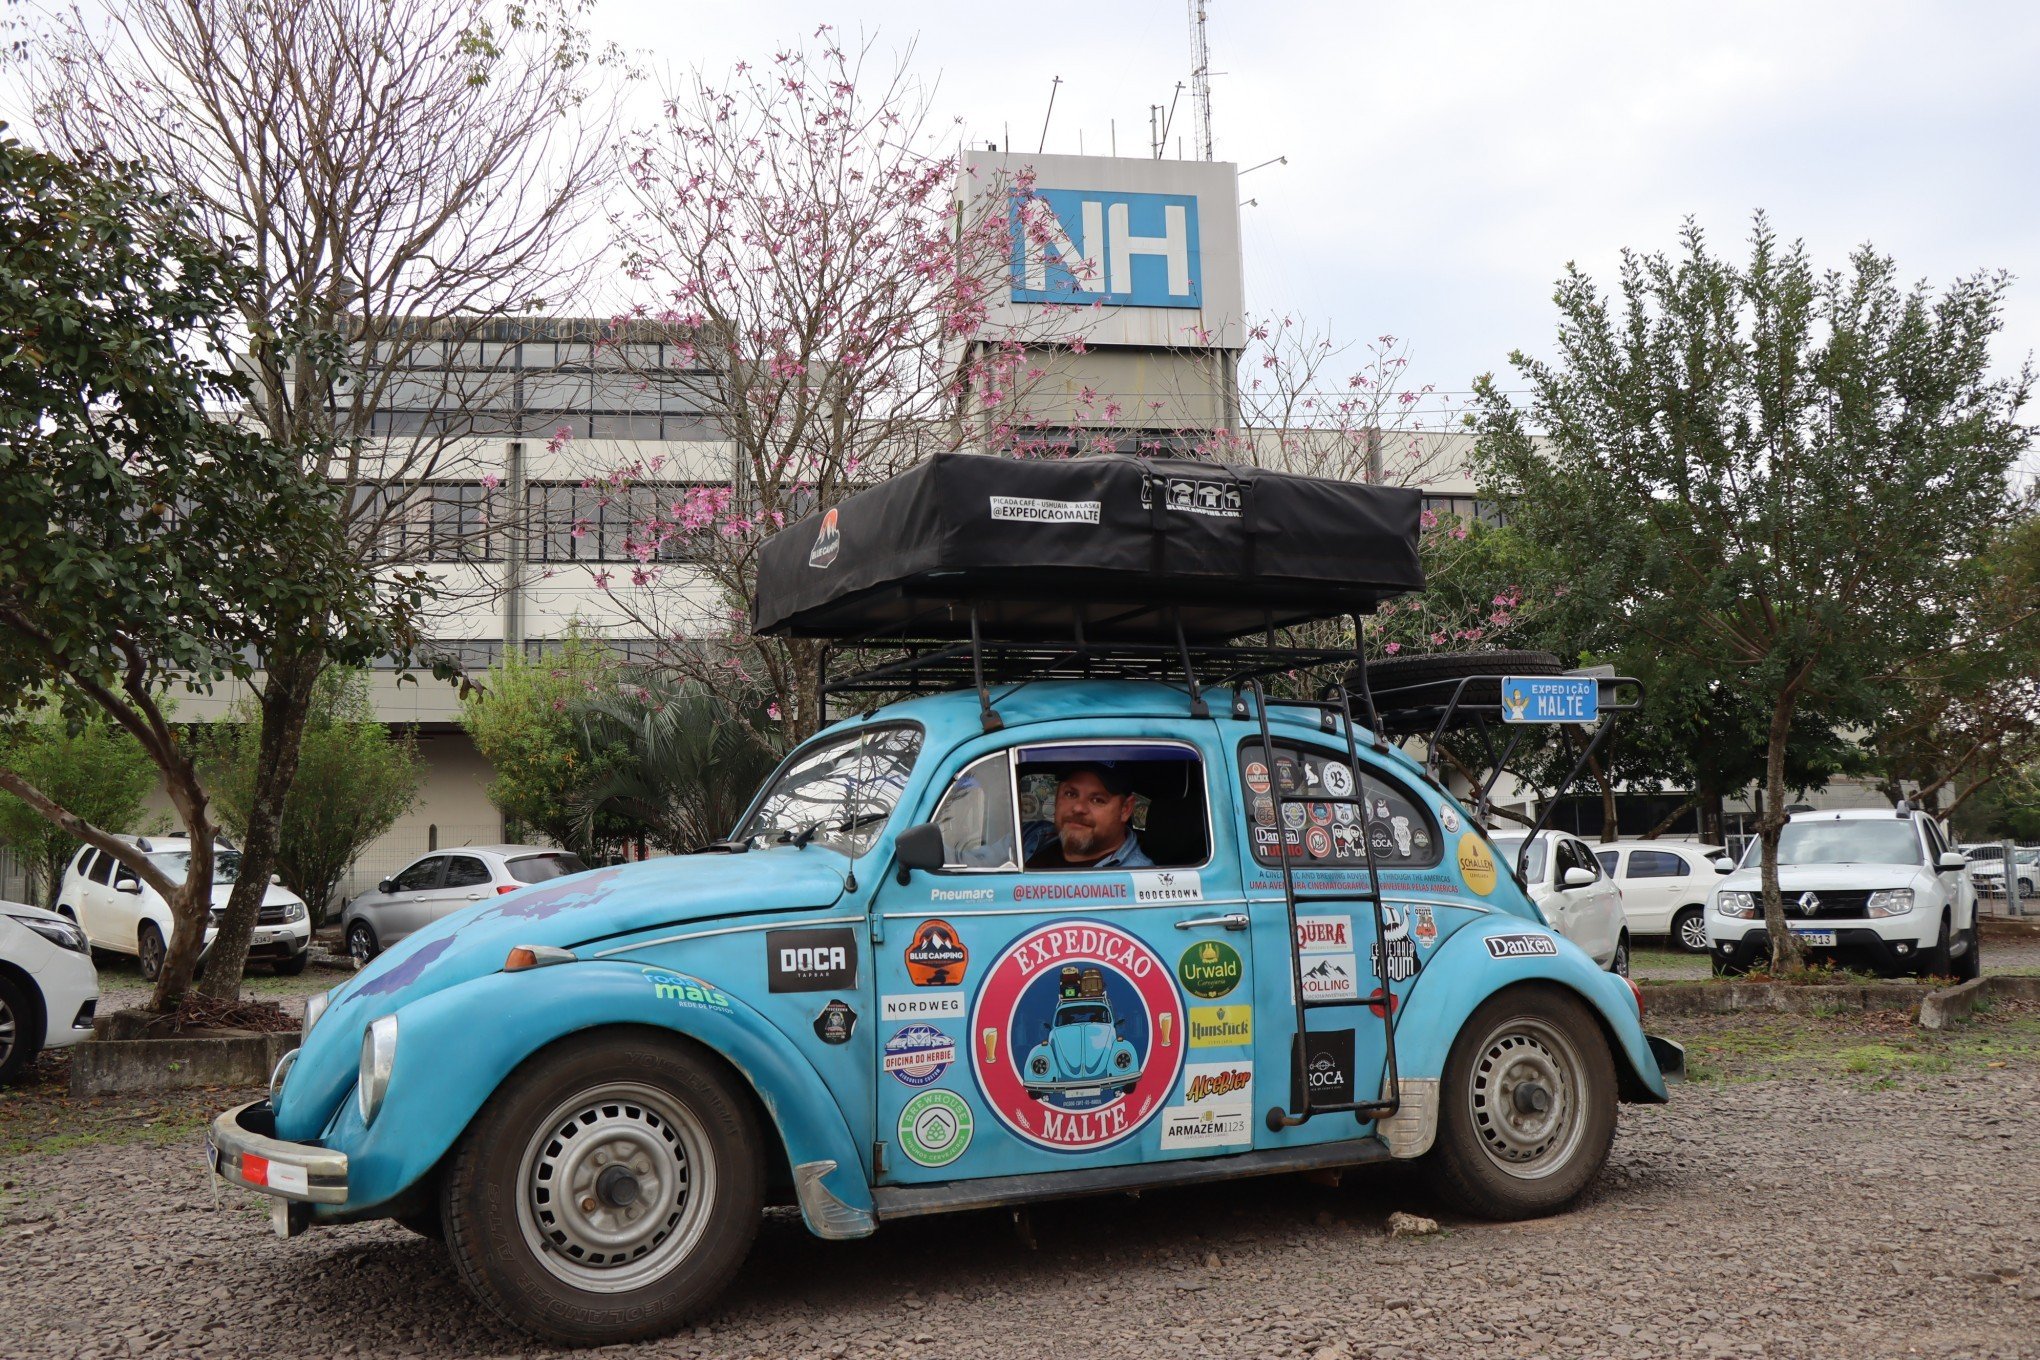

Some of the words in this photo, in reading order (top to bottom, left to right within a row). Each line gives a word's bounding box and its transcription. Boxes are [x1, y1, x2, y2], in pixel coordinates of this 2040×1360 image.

[1025, 199, 1189, 296] NH
[993, 497, 1019, 505] PICADA
[1020, 499, 1035, 507] CAFÉ
[1041, 501, 1068, 509] USHUAIA
[993, 506, 1099, 521] @EXPEDICAOMALTE
[1532, 683, 1590, 698] EXPEDIÇÃO
[1538, 696, 1584, 716] MALTE
[1340, 812, 1350, 821] 40
[1258, 829, 1297, 842] Danen
[1460, 858, 1494, 872] SCHALLEN
[1013, 884, 1127, 901] @EXPEDICAOMALTE
[1250, 881, 1267, 890] UMA
[931, 888, 994, 901] Pneumarc
[1139, 889, 1198, 900] BODEBROWN
[1487, 936, 1555, 956] Danken
[780, 947, 846, 972] DOCA
[910, 952, 929, 960] BLUE
[928, 952, 964, 960] CAMPING
[1185, 961, 1237, 980] Urwald
[1371, 956, 1414, 980] TAUM
[1301, 980, 1350, 992] KOLLING
[655, 983, 729, 1007] mais
[679, 1001, 698, 1009] REDE
[708, 1004, 734, 1015] POSTOS
[887, 1000, 959, 1013] NORDWEG
[886, 1056, 914, 1068] OFICINA
[915, 1054, 925, 1064] DO
[926, 1050, 951, 1063] HERBIE
[905, 1094, 968, 1122] BREWHOUSE
[1041, 1102, 1129, 1142] MALTE
[906, 1137, 928, 1159] INSUMOS
[928, 1135, 966, 1160] CERVEJEIROS
